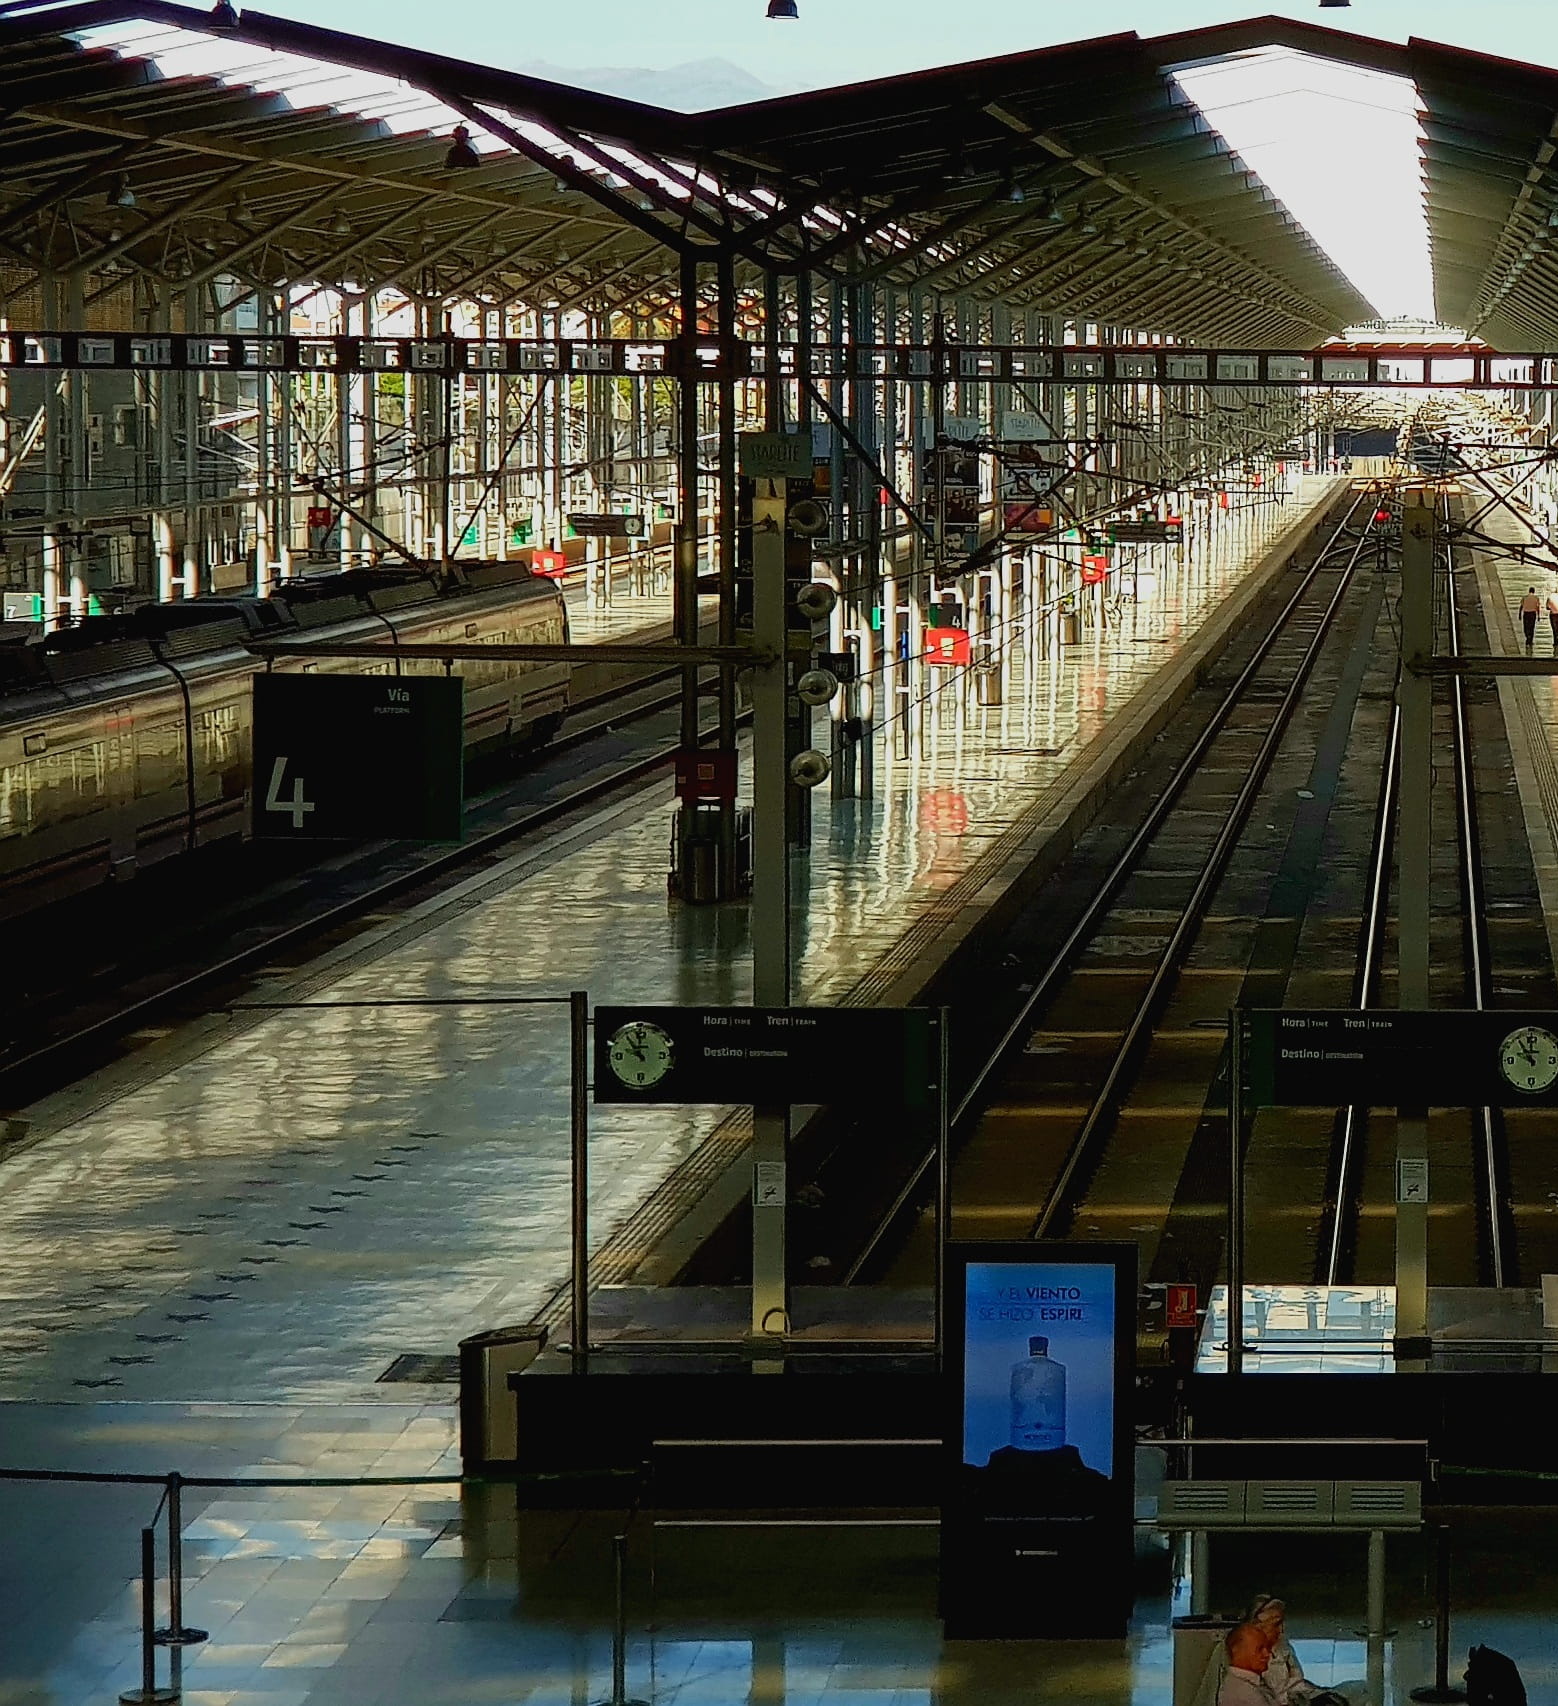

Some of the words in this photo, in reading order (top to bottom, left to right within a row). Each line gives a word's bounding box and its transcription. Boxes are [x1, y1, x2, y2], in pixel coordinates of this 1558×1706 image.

[265, 756, 315, 828] 4
[703, 1015, 728, 1025] Hora
[767, 1015, 789, 1025] Tren
[1281, 1018, 1306, 1028] Hora
[1343, 1018, 1366, 1028] Tren
[703, 1047, 743, 1057] Destino
[1281, 1048, 1320, 1059] Destino
[1026, 1287, 1082, 1300] VIENTO
